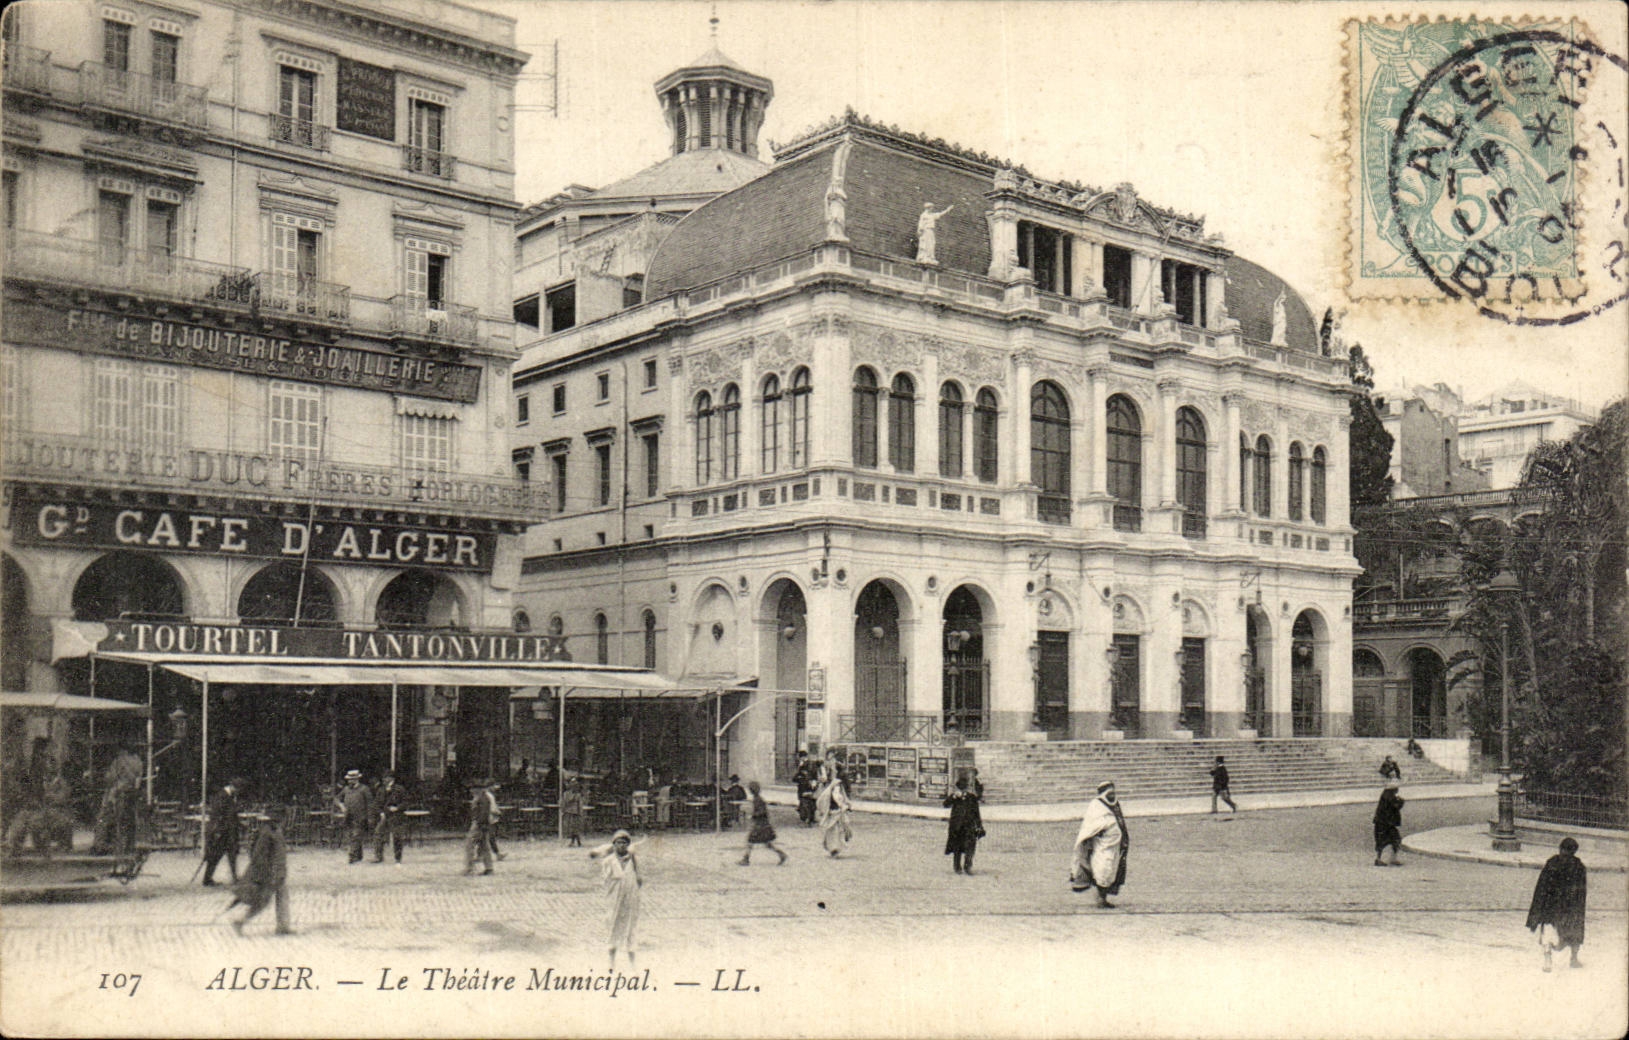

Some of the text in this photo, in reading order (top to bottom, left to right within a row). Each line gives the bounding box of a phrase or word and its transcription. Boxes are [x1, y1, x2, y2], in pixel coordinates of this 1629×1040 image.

[117, 318, 139, 340] de
[151, 322, 291, 363] BIJOUTERIE
[294, 347, 305, 365] &
[313, 347, 436, 383] JOAILLERIE
[189, 450, 268, 487] DUC
[115, 510, 248, 550] CAFE
[281, 522, 479, 566] D'ALGER
[131, 623, 550, 661] TOURTEL TANTONVILLE
